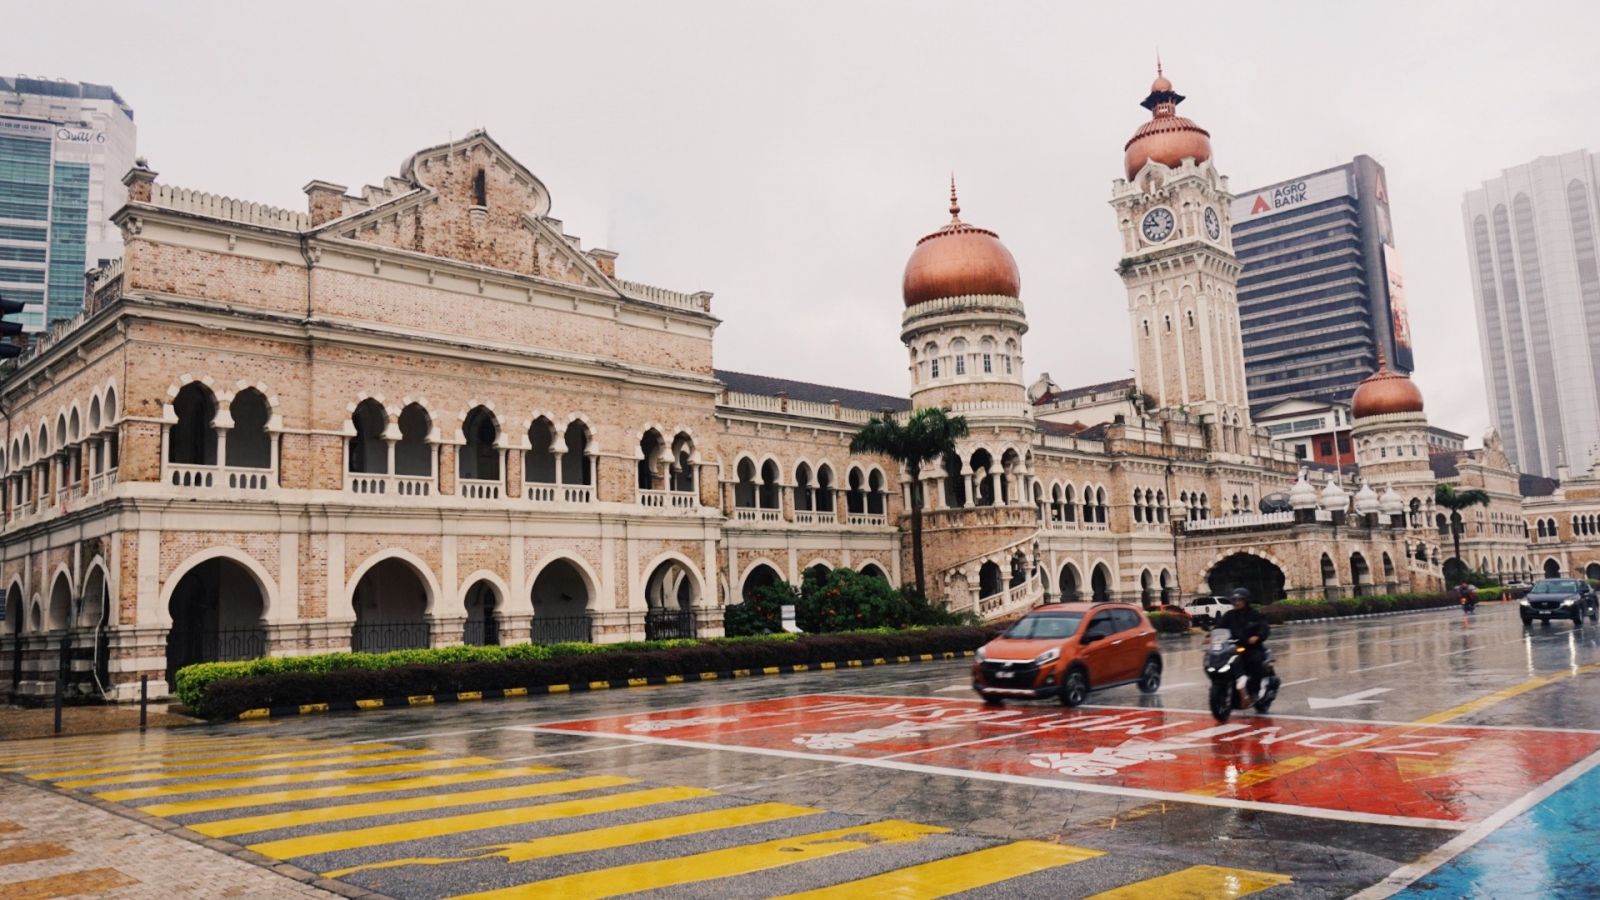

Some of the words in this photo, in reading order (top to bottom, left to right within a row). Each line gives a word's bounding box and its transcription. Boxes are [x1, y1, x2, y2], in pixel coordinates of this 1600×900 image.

[96, 132, 105, 143] 6
[1274, 182, 1307, 199] AGRO
[1274, 192, 1308, 209] BANK
